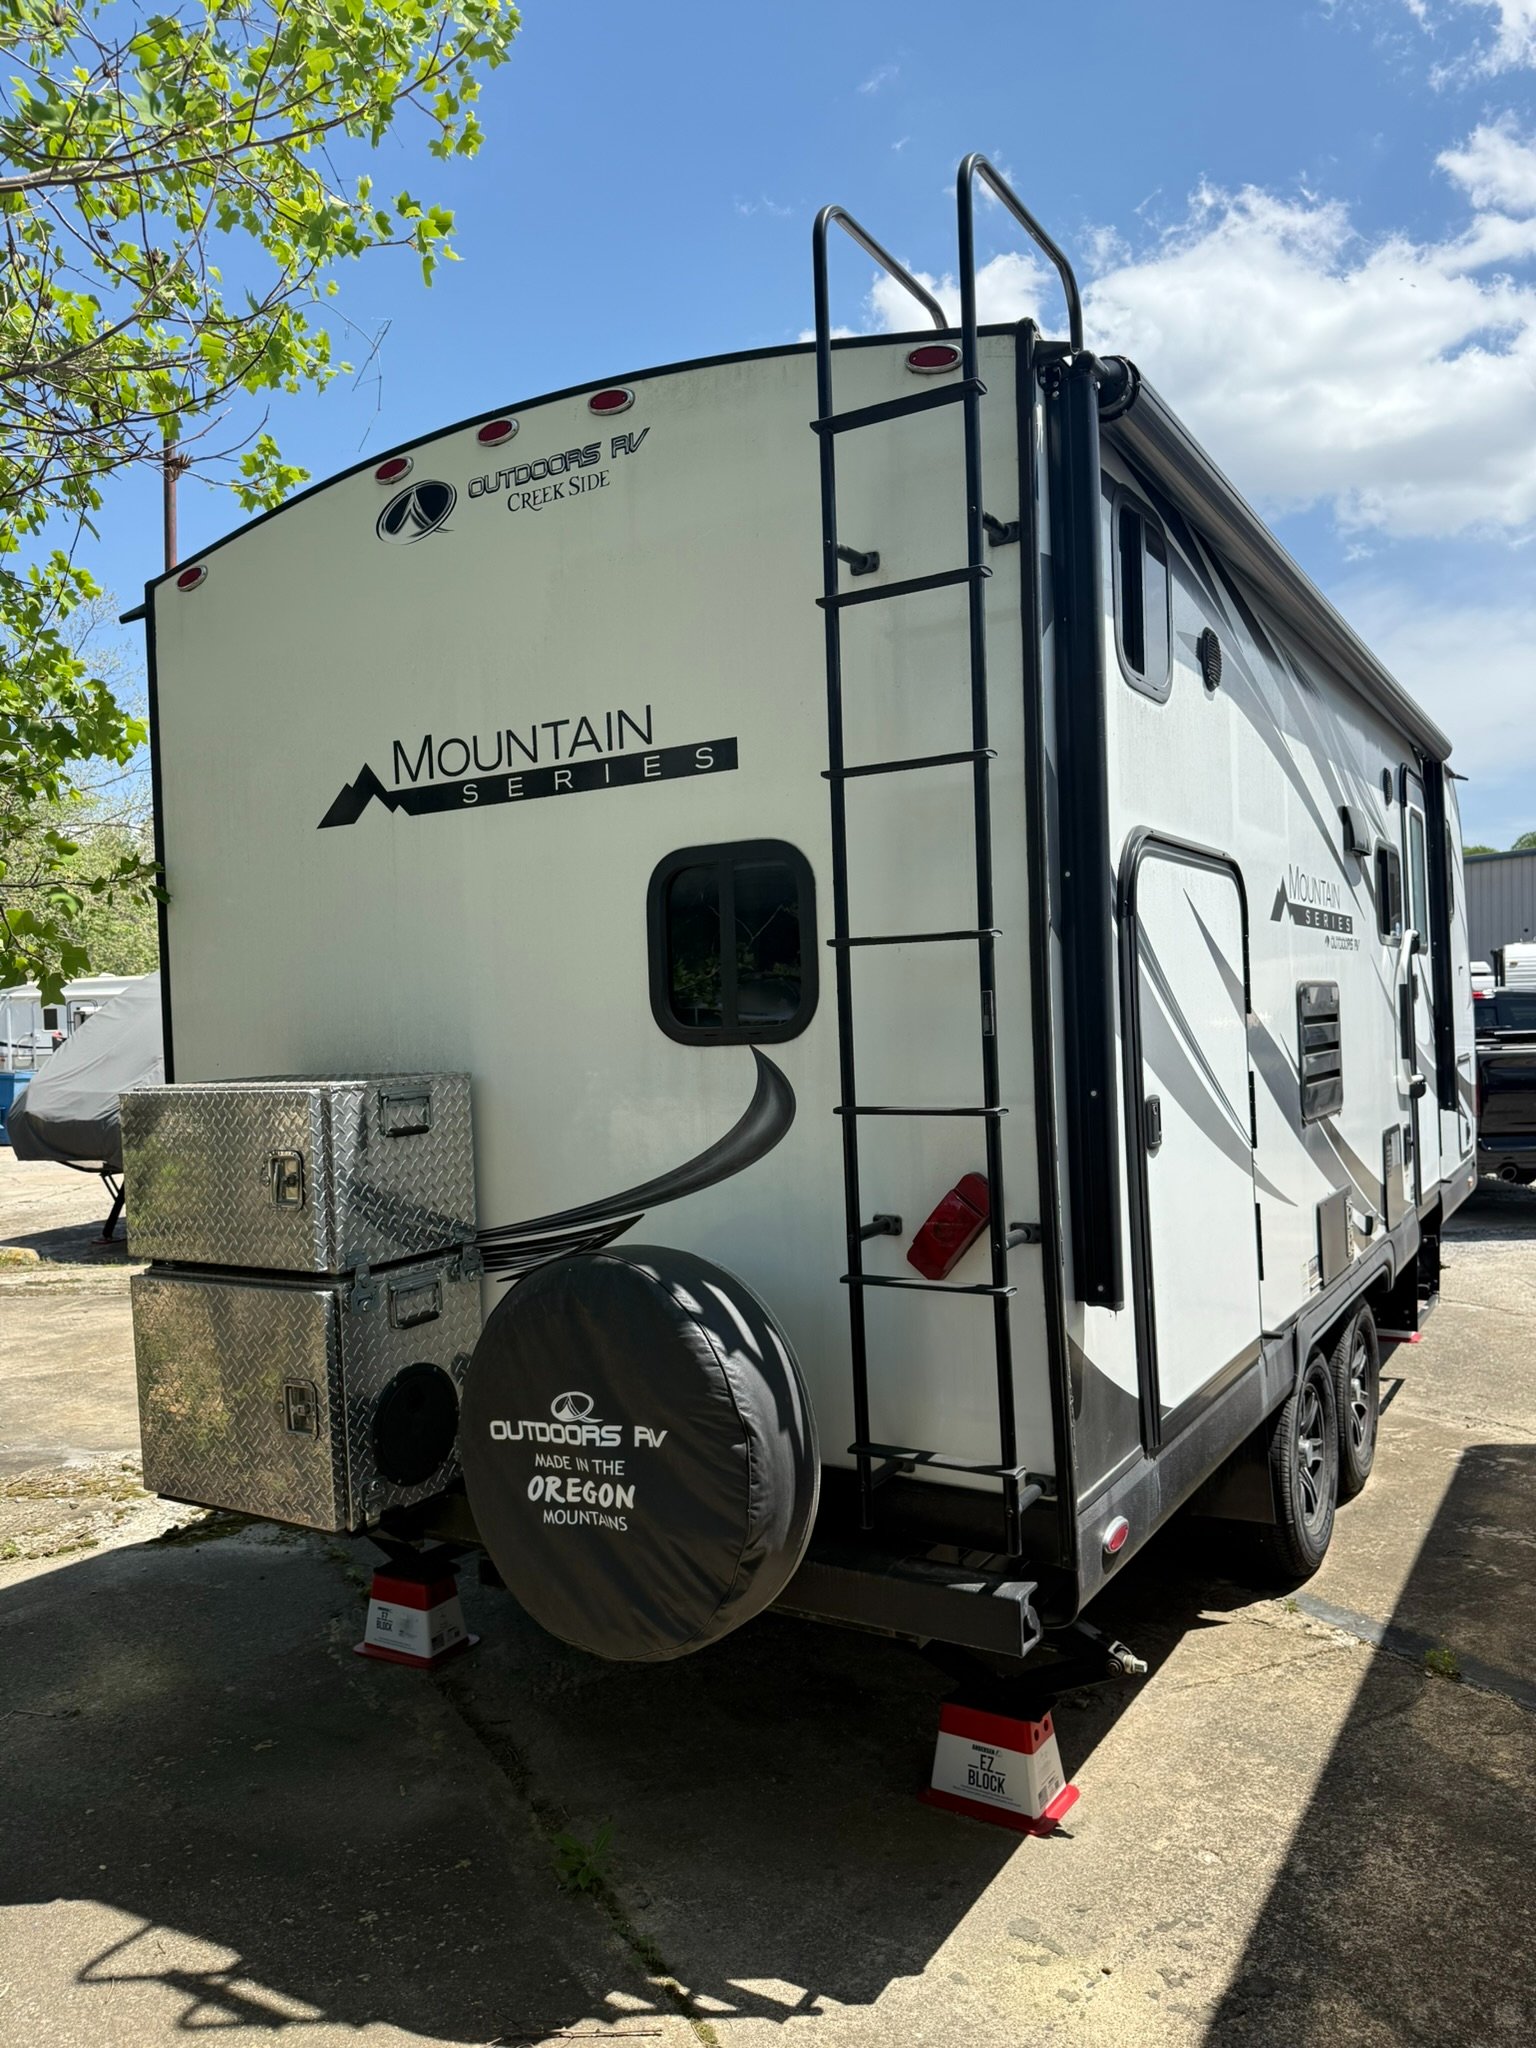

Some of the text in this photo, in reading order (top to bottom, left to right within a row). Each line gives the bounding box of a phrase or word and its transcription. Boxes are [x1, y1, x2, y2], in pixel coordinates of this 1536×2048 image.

[468, 426, 651, 499] OUTDOORS RV
[507, 470, 610, 512] CREEK SIDE
[392, 704, 653, 785] MOUNTAIN
[462, 747, 714, 803] SERIES
[1289, 864, 1340, 909] MOUNTAIN
[1305, 909, 1351, 932] SERIES
[490, 1420, 668, 1449] OUTDOORS RV
[535, 1453, 625, 1476] MADE IN THE
[527, 1475, 636, 1509] OREGON
[543, 1509, 628, 1532] MOUNTAINS
[980, 1754, 994, 1773] EZ
[968, 1769, 1005, 1794] BLOCK
